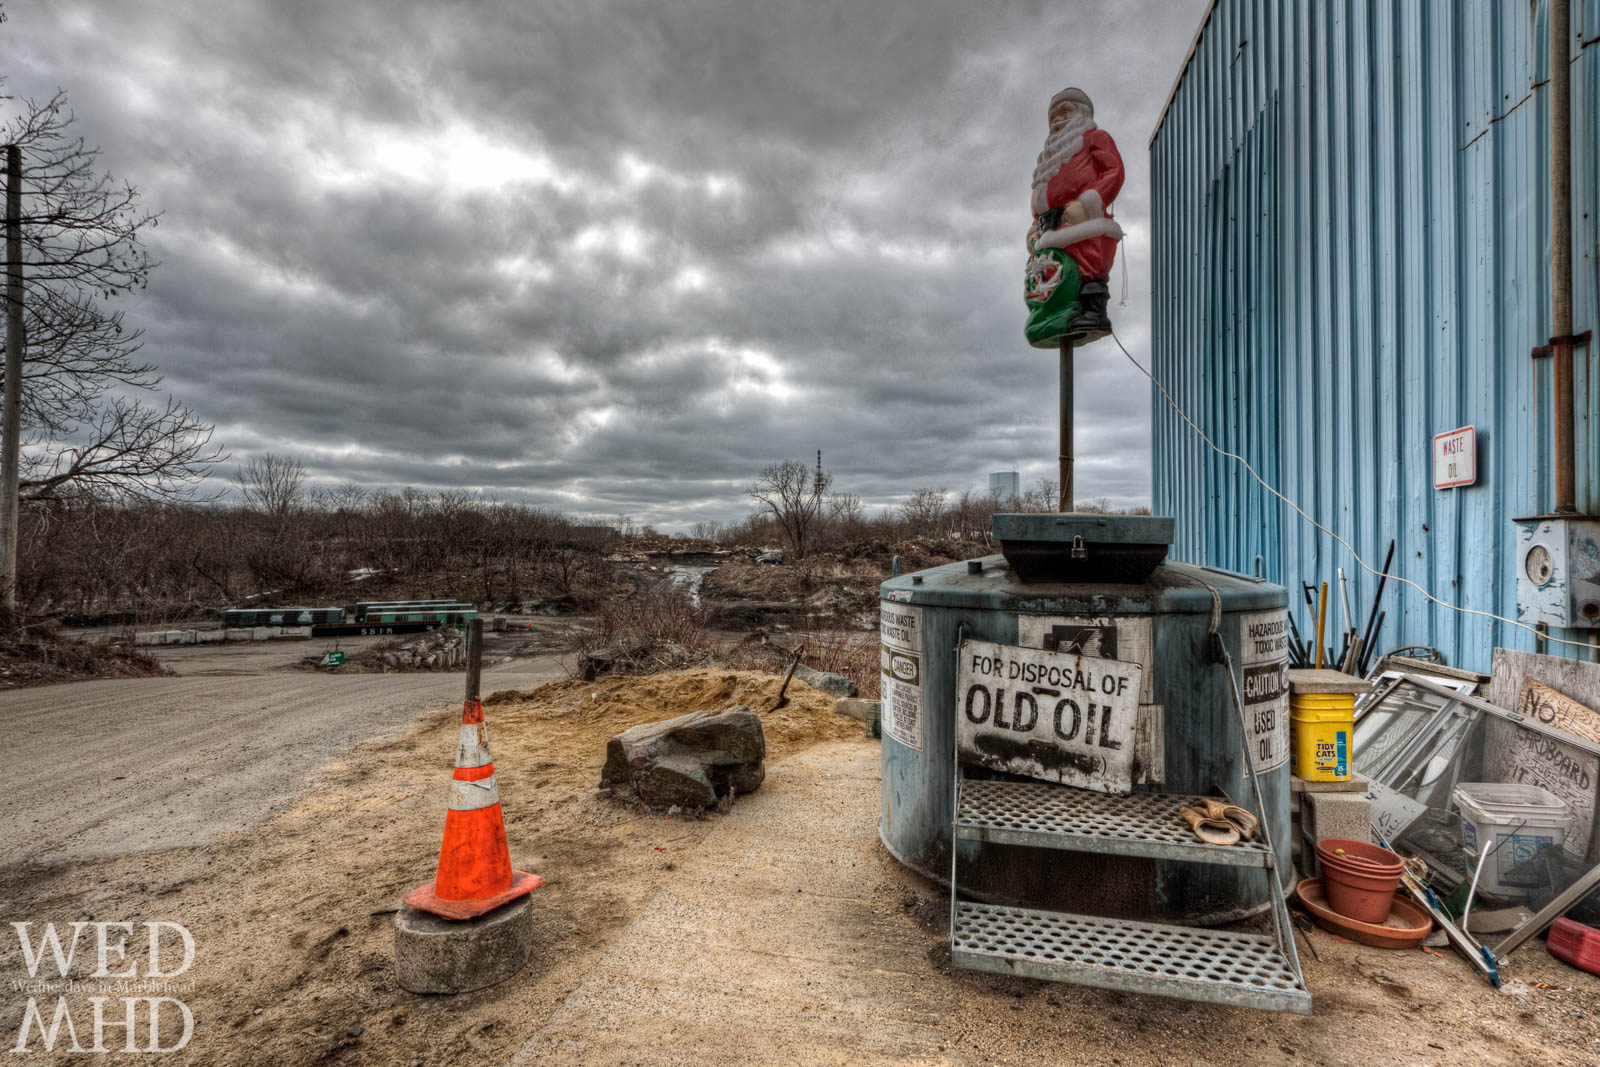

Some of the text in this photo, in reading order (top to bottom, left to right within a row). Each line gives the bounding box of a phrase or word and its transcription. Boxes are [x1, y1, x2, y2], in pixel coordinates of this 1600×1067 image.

[1443, 436, 1464, 456] WASTE
[1448, 463, 1458, 478] OIL
[895, 614, 916, 628] WASTE
[1249, 621, 1284, 638] HAZARDOUS
[886, 625, 901, 640] WASTE
[901, 629, 911, 643] OIL
[1254, 639, 1274, 655] TOXIC
[893, 658, 914, 677] DANGER
[972, 655, 1129, 697] FOR DISPOSAL OF
[1246, 671, 1279, 699] CAUTION
[965, 684, 1122, 751] OLD OIL
[1254, 709, 1276, 735] USED
[1260, 738, 1273, 762] OIL
[1315, 750, 1336, 758] CATS
